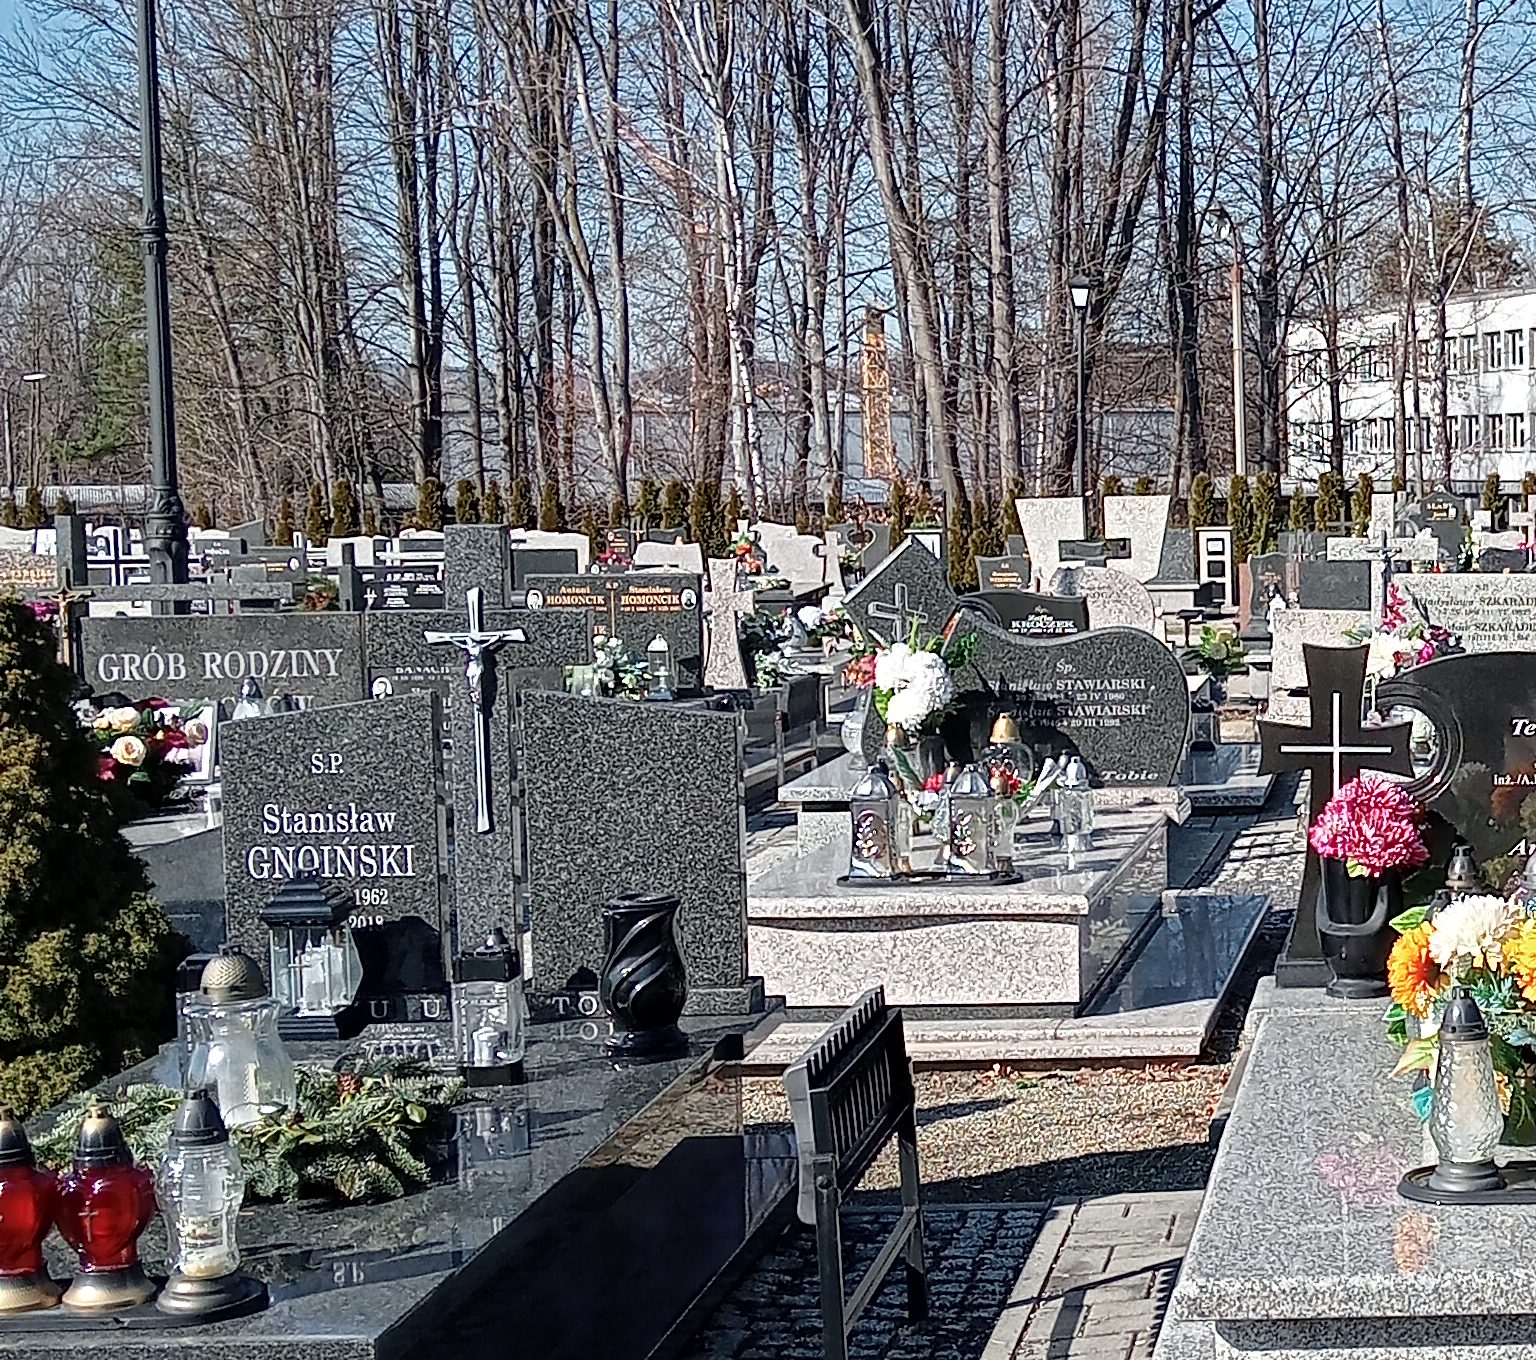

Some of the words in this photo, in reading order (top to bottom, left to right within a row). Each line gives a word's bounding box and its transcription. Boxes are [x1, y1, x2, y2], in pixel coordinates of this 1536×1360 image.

[98, 646, 187, 682] GRÓB
[203, 648, 344, 679] RODZINY
[1056, 679, 1146, 691] STAWIARSKI
[311, 748, 344, 774] Ś.P.
[1101, 770, 1159, 782] Tobie
[263, 802, 397, 835] Stanisław
[248, 837, 416, 879] GNOIŃSKI
[354, 888, 388, 906] 1962
